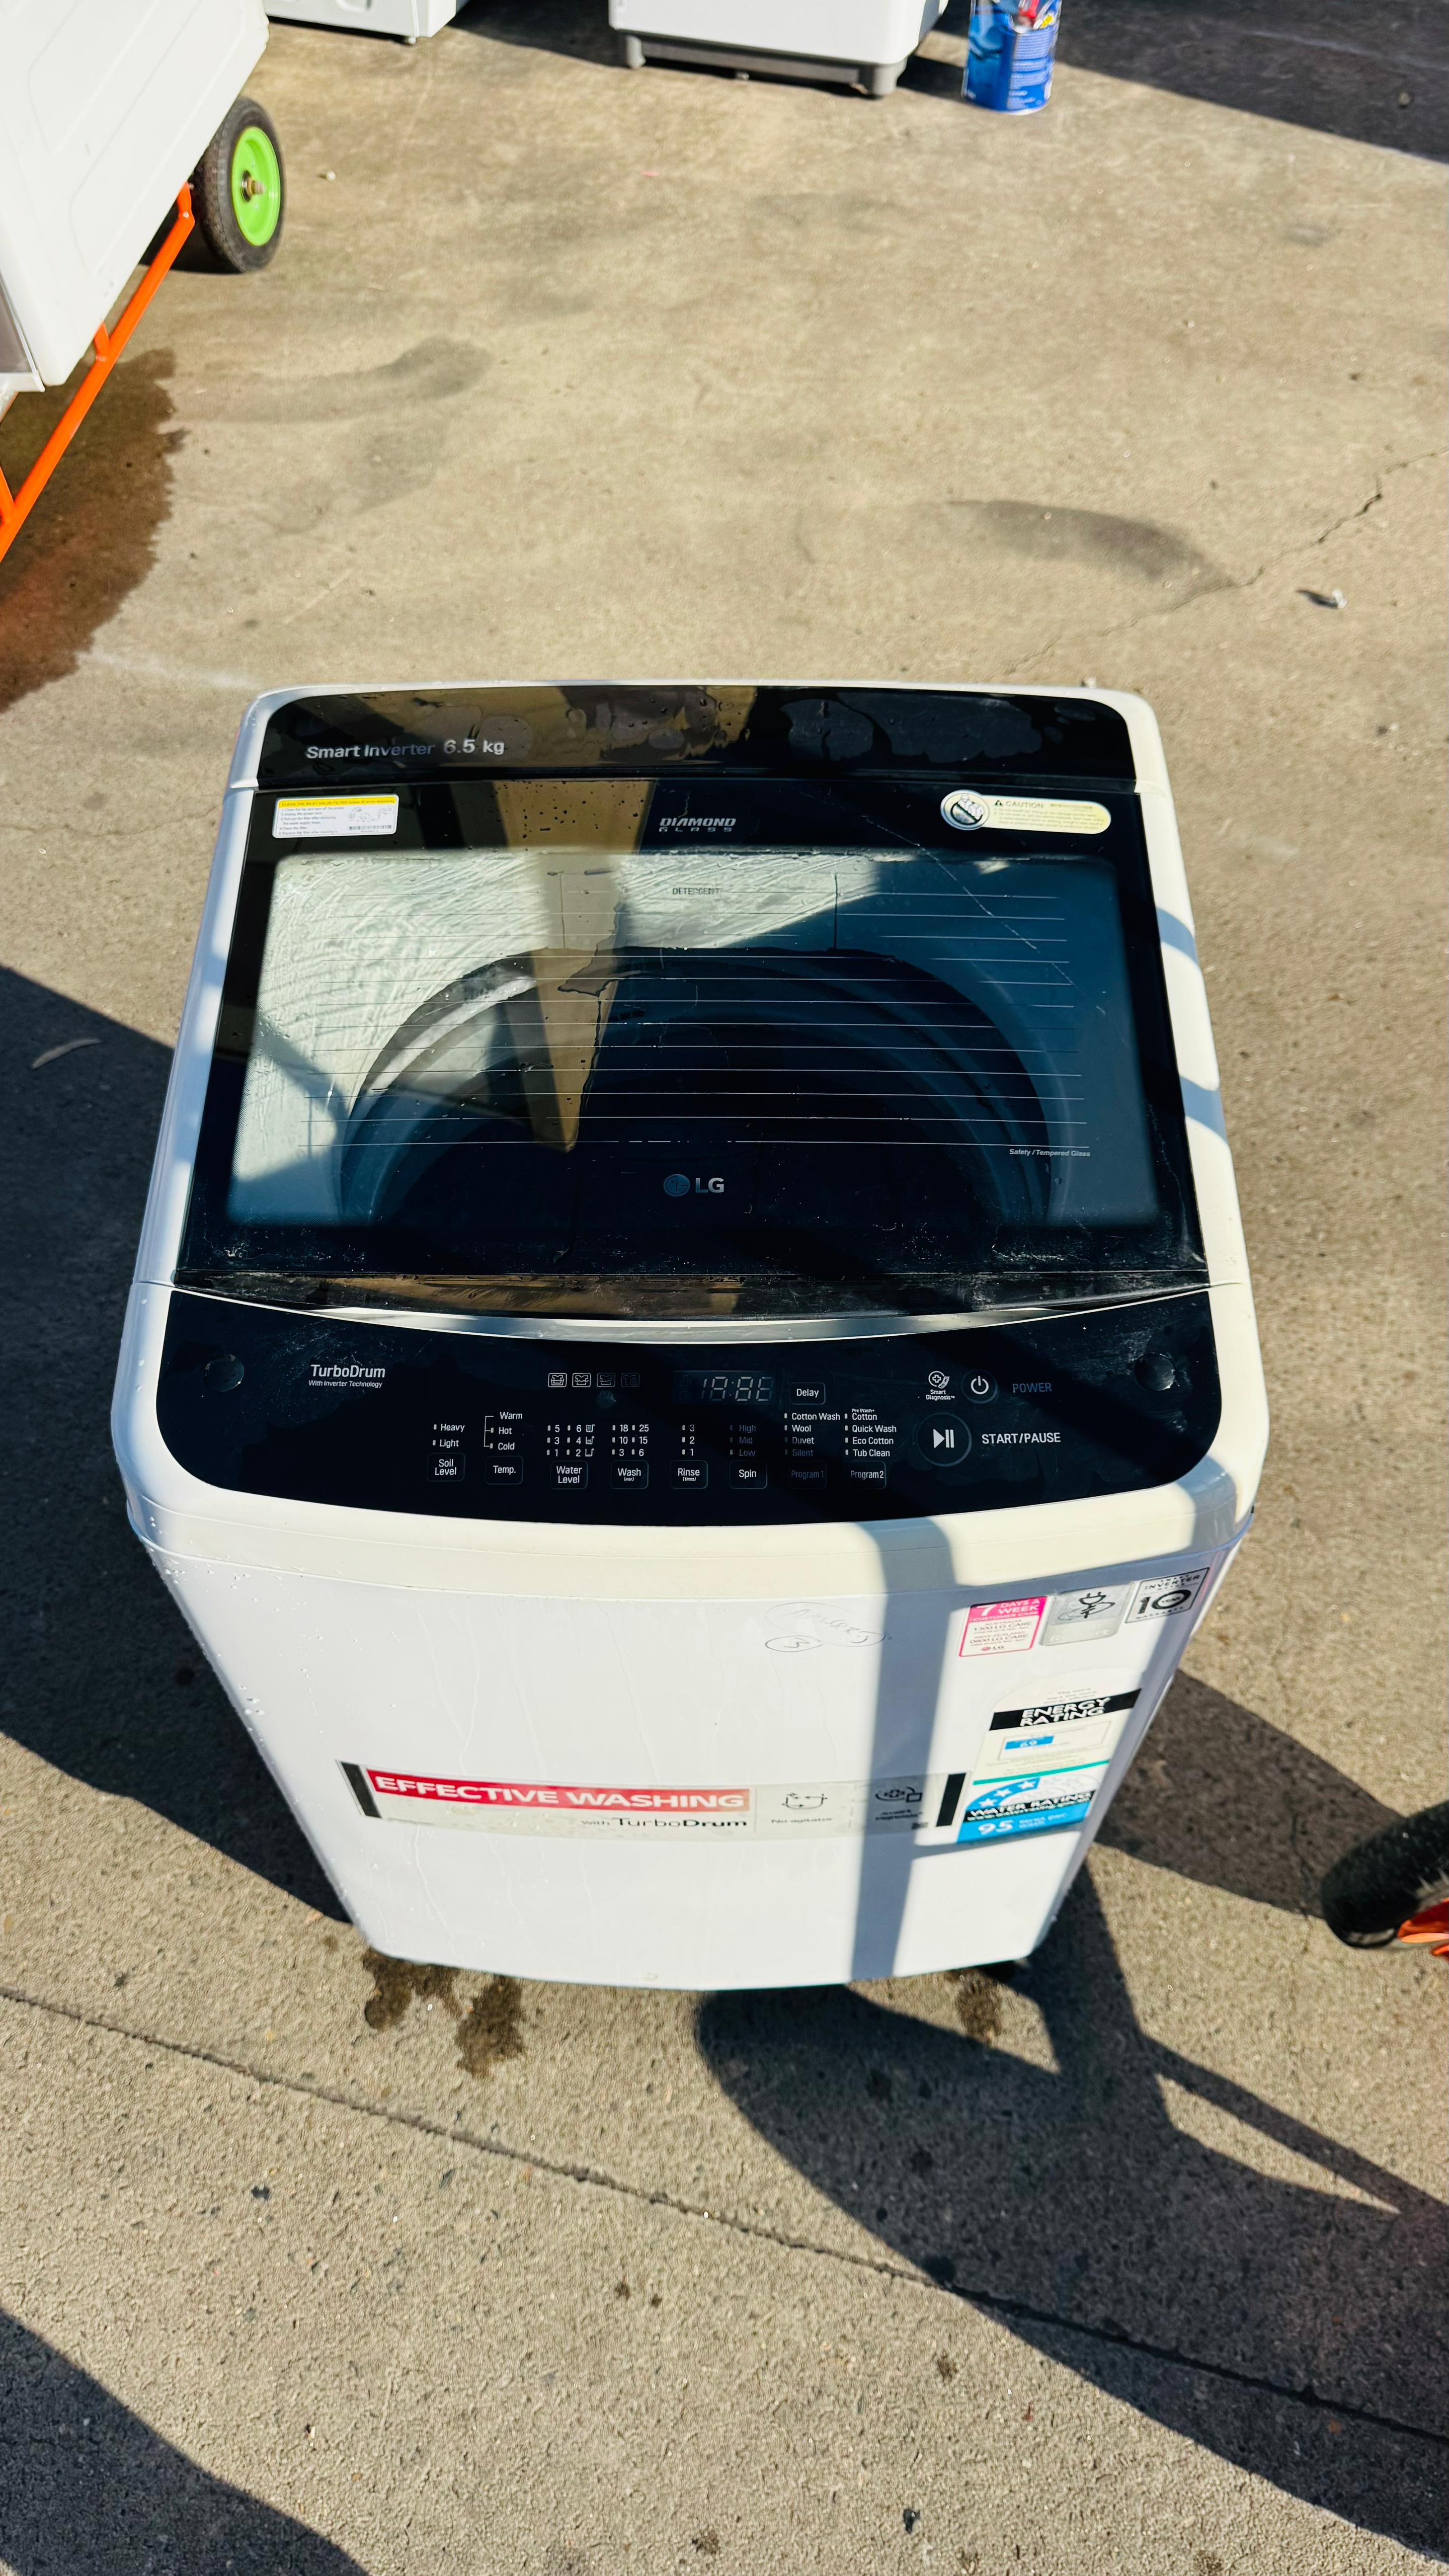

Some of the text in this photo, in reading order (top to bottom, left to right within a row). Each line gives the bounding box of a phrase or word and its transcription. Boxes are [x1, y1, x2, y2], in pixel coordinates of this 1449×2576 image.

[306, 739, 505, 759] Smart Inverter 6.5 kg
[1006, 800, 1043, 809] CAUTION
[660, 818, 736, 826] DIAMOND
[695, 1177, 725, 1193] LG
[310, 1364, 385, 1378] TurboDrum
[1012, 1383, 1052, 1393] POWER
[796, 1389, 819, 1398] Delay
[440, 1424, 465, 1432] Heavy
[554, 1424, 582, 1432] 5 6
[739, 1425, 756, 1433] High
[852, 1425, 873, 1433] Quick
[554, 1436, 581, 1444] 3 4
[619, 1436, 648, 1444] 10 15
[689, 1436, 695, 1444] 2
[982, 1432, 1061, 1444] START/PAUSE
[439, 1439, 459, 1448] Light
[498, 1442, 515, 1451] Cold
[619, 1448, 644, 1457] 3 6
[739, 1448, 756, 1457] Low
[438, 1459, 454, 1467] Soil
[435, 1467, 457, 1476] Level
[493, 1465, 516, 1475] Temp.
[556, 1466, 582, 1474] Water
[617, 1468, 641, 1476] Wash
[678, 1468, 700, 1476] Rinse
[739, 1469, 757, 1479] Spin
[557, 1475, 580, 1484] Level
[1145, 1574, 1200, 1590] INVERTER
[1138, 1589, 1191, 1615] 10
[976, 1603, 997, 1617] 7
[998, 1604, 1039, 1615] WEEK
[973, 1614, 1016, 1622] CUSTOMER
[1022, 1697, 1111, 1719] ENERGY
[1019, 1707, 1105, 1727] RATING
[375, 1776, 744, 1808] EFFECTIVE WASHING
[970, 1803, 1026, 1817] WATER
[611, 1817, 747, 1827] TurboDrum
[978, 1819, 1014, 1835] 95
